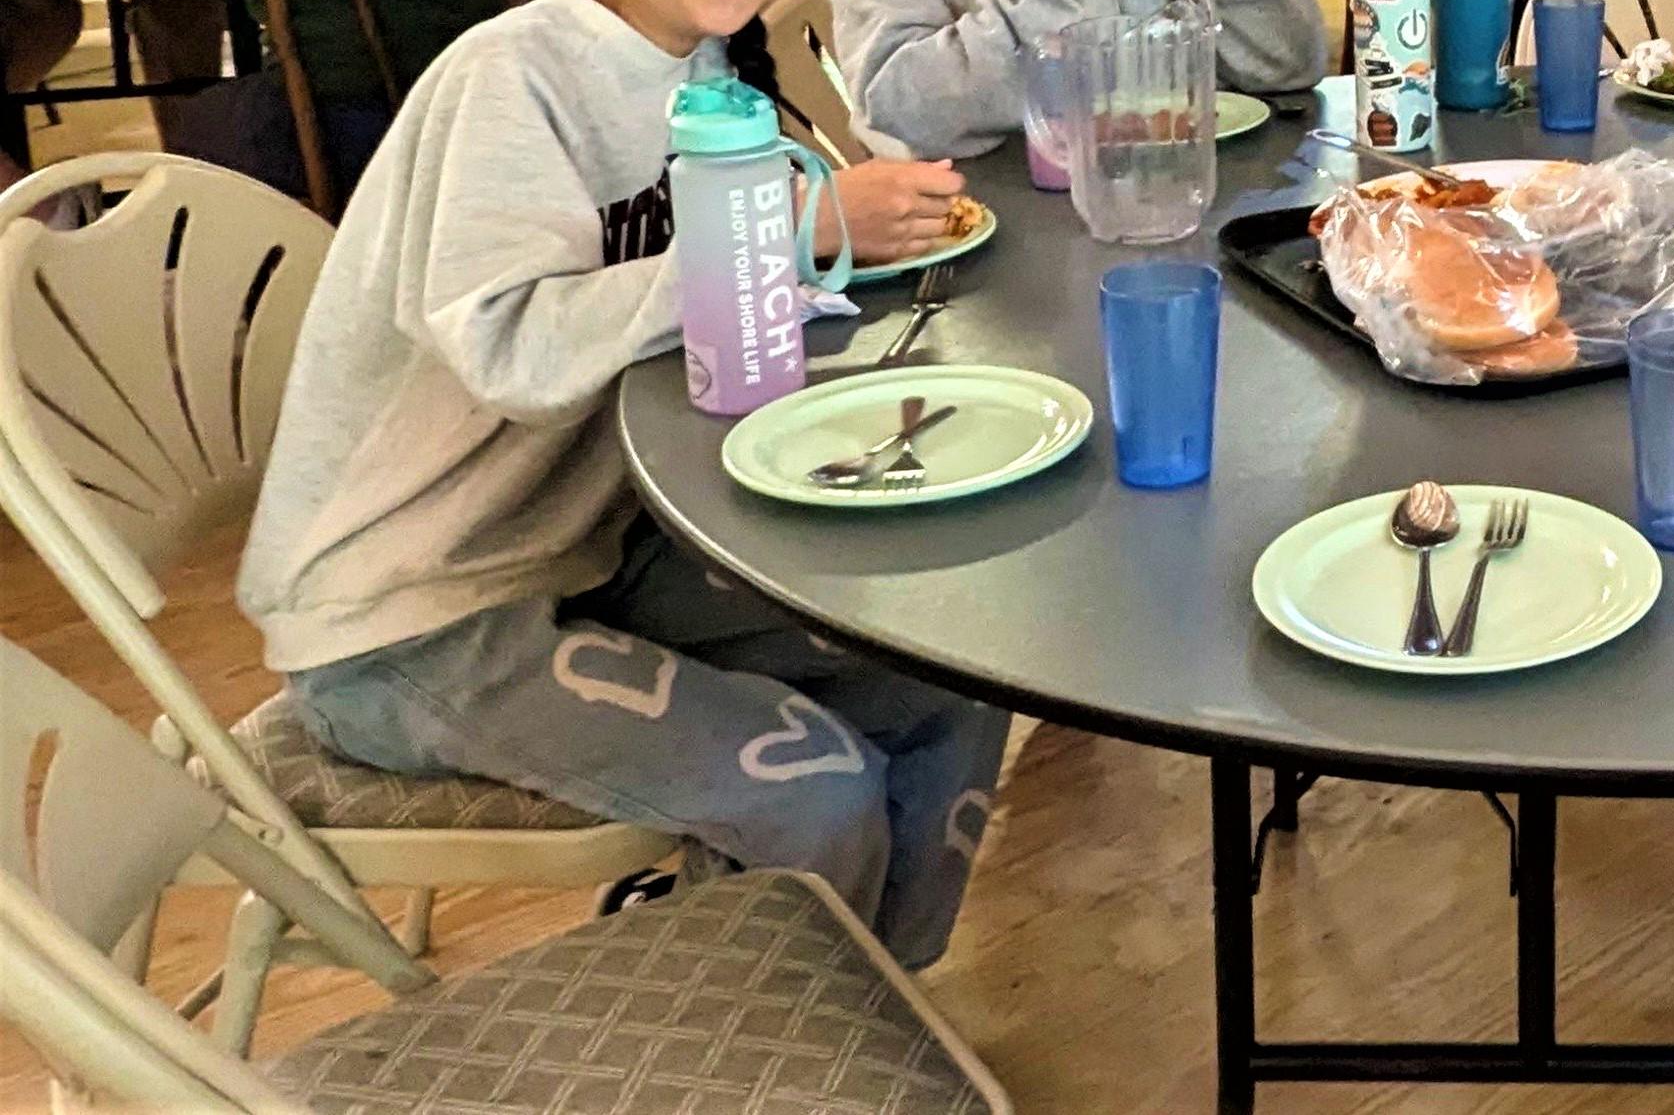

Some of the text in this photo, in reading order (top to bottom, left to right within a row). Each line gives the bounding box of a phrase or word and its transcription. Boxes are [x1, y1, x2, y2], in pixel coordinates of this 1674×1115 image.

[728, 189, 761, 385] ENJOY YOUR SHORE LIFE
[754, 180, 797, 357] BEACH
